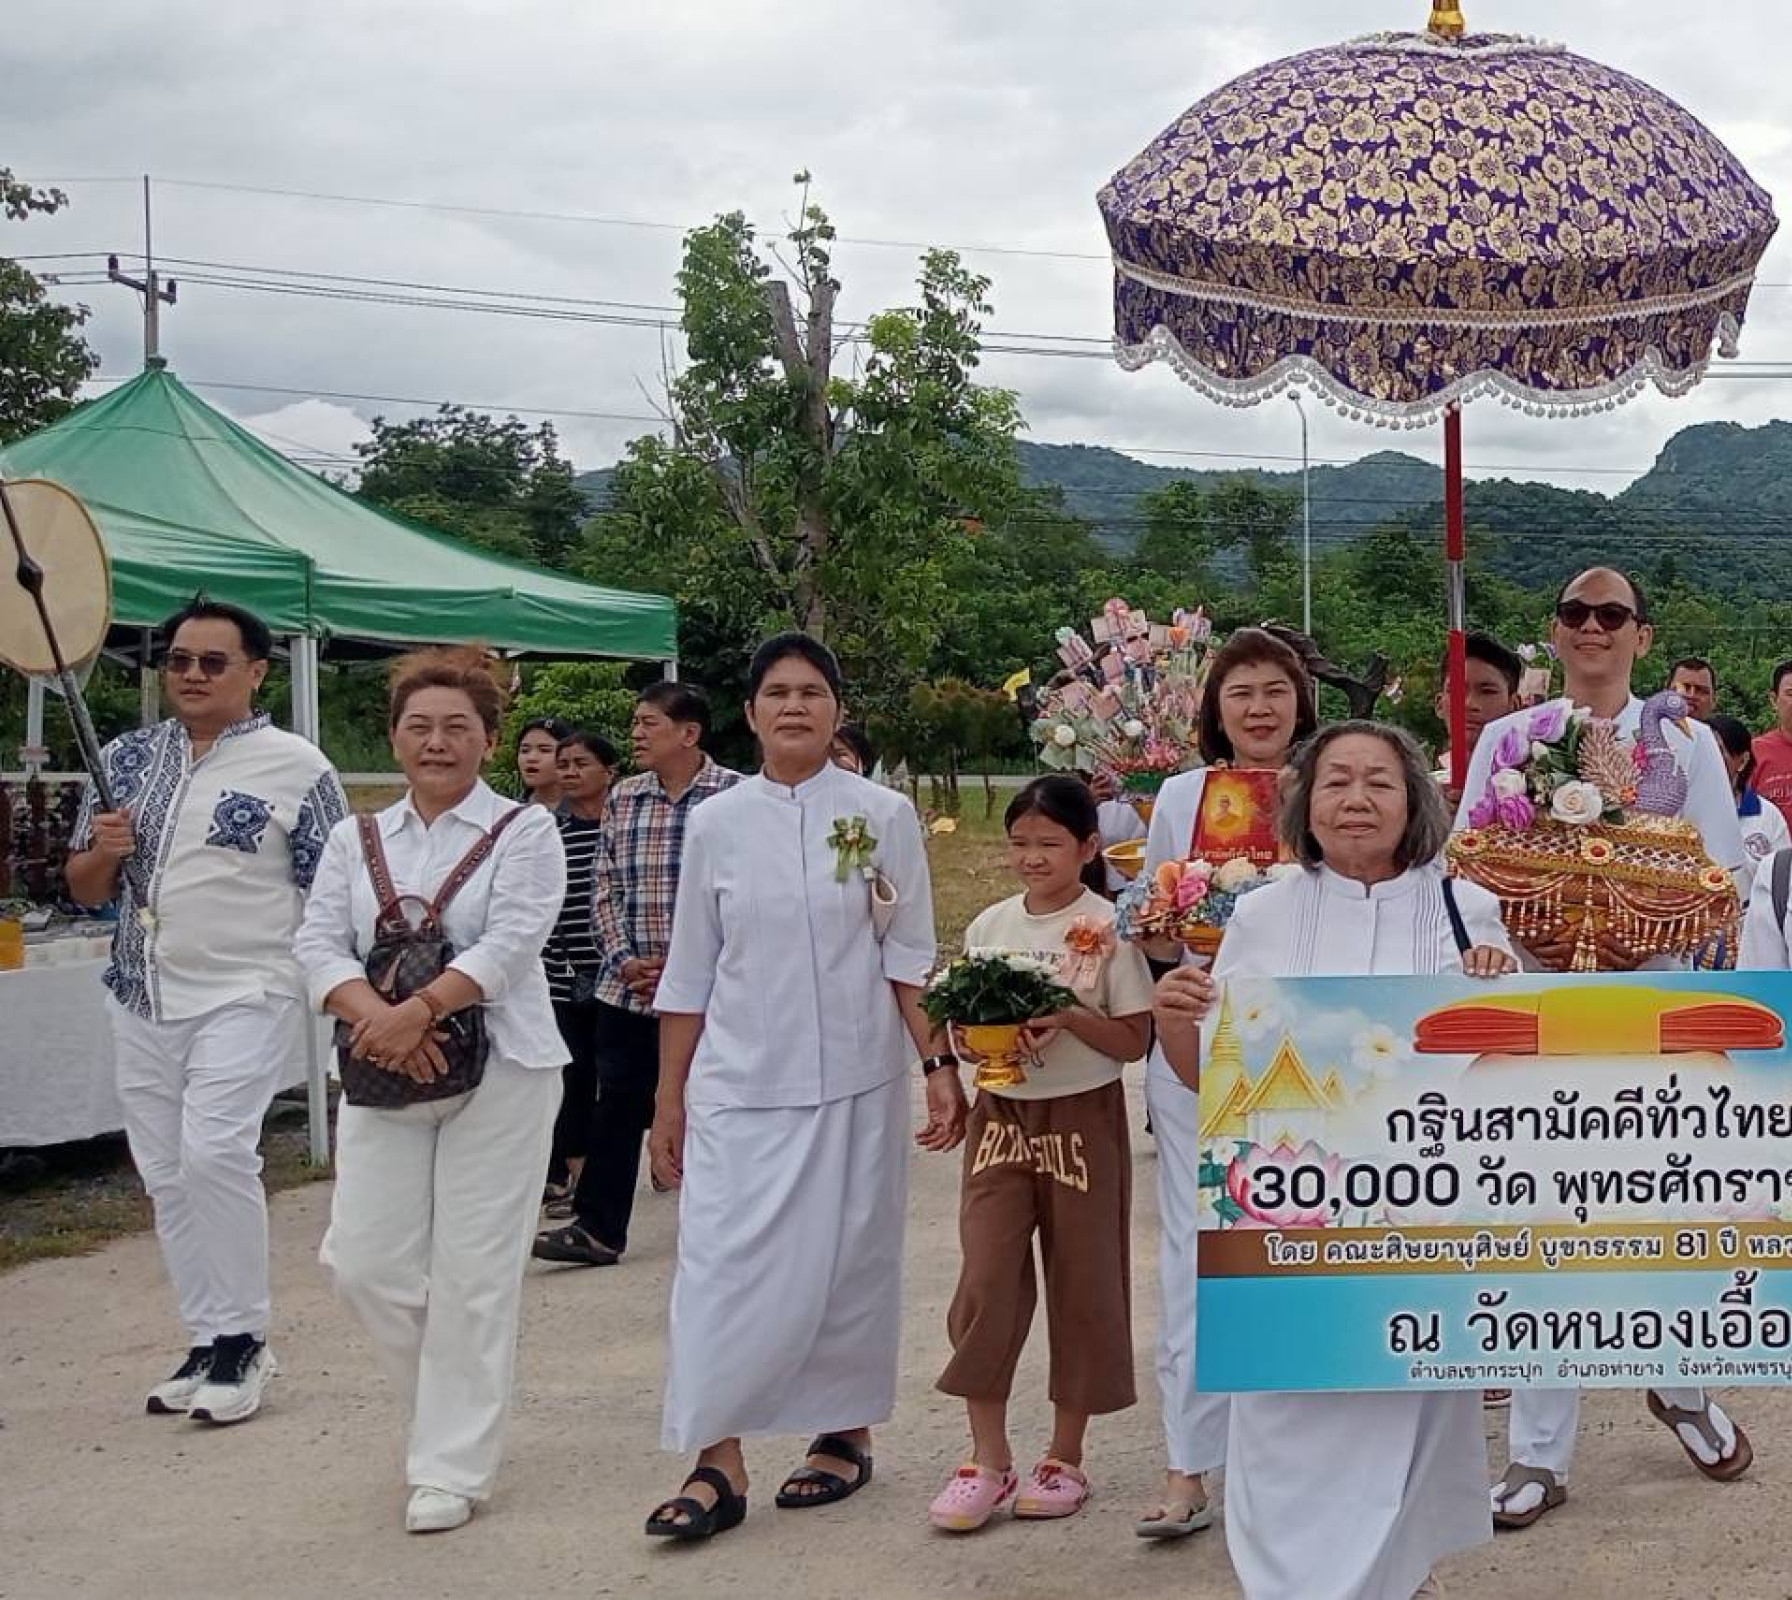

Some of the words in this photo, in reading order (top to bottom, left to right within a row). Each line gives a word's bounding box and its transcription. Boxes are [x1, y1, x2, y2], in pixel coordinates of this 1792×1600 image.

[1251, 1162, 1460, 1215] 30,000
[1476, 1154, 1537, 1206] วัด
[1268, 1235, 1315, 1262] โดย
[1326, 1231, 1530, 1270] คณะศิษยานุศิษย์
[1540, 1239, 1662, 1266] บูชาธรรม
[1676, 1232, 1707, 1257] 81
[1719, 1229, 1737, 1256] ปี
[1388, 1311, 1440, 1352] ณ
[1411, 1360, 1543, 1383] ตำบลเขากระปุก
[1557, 1358, 1664, 1378] อำเภอท่ายาง
